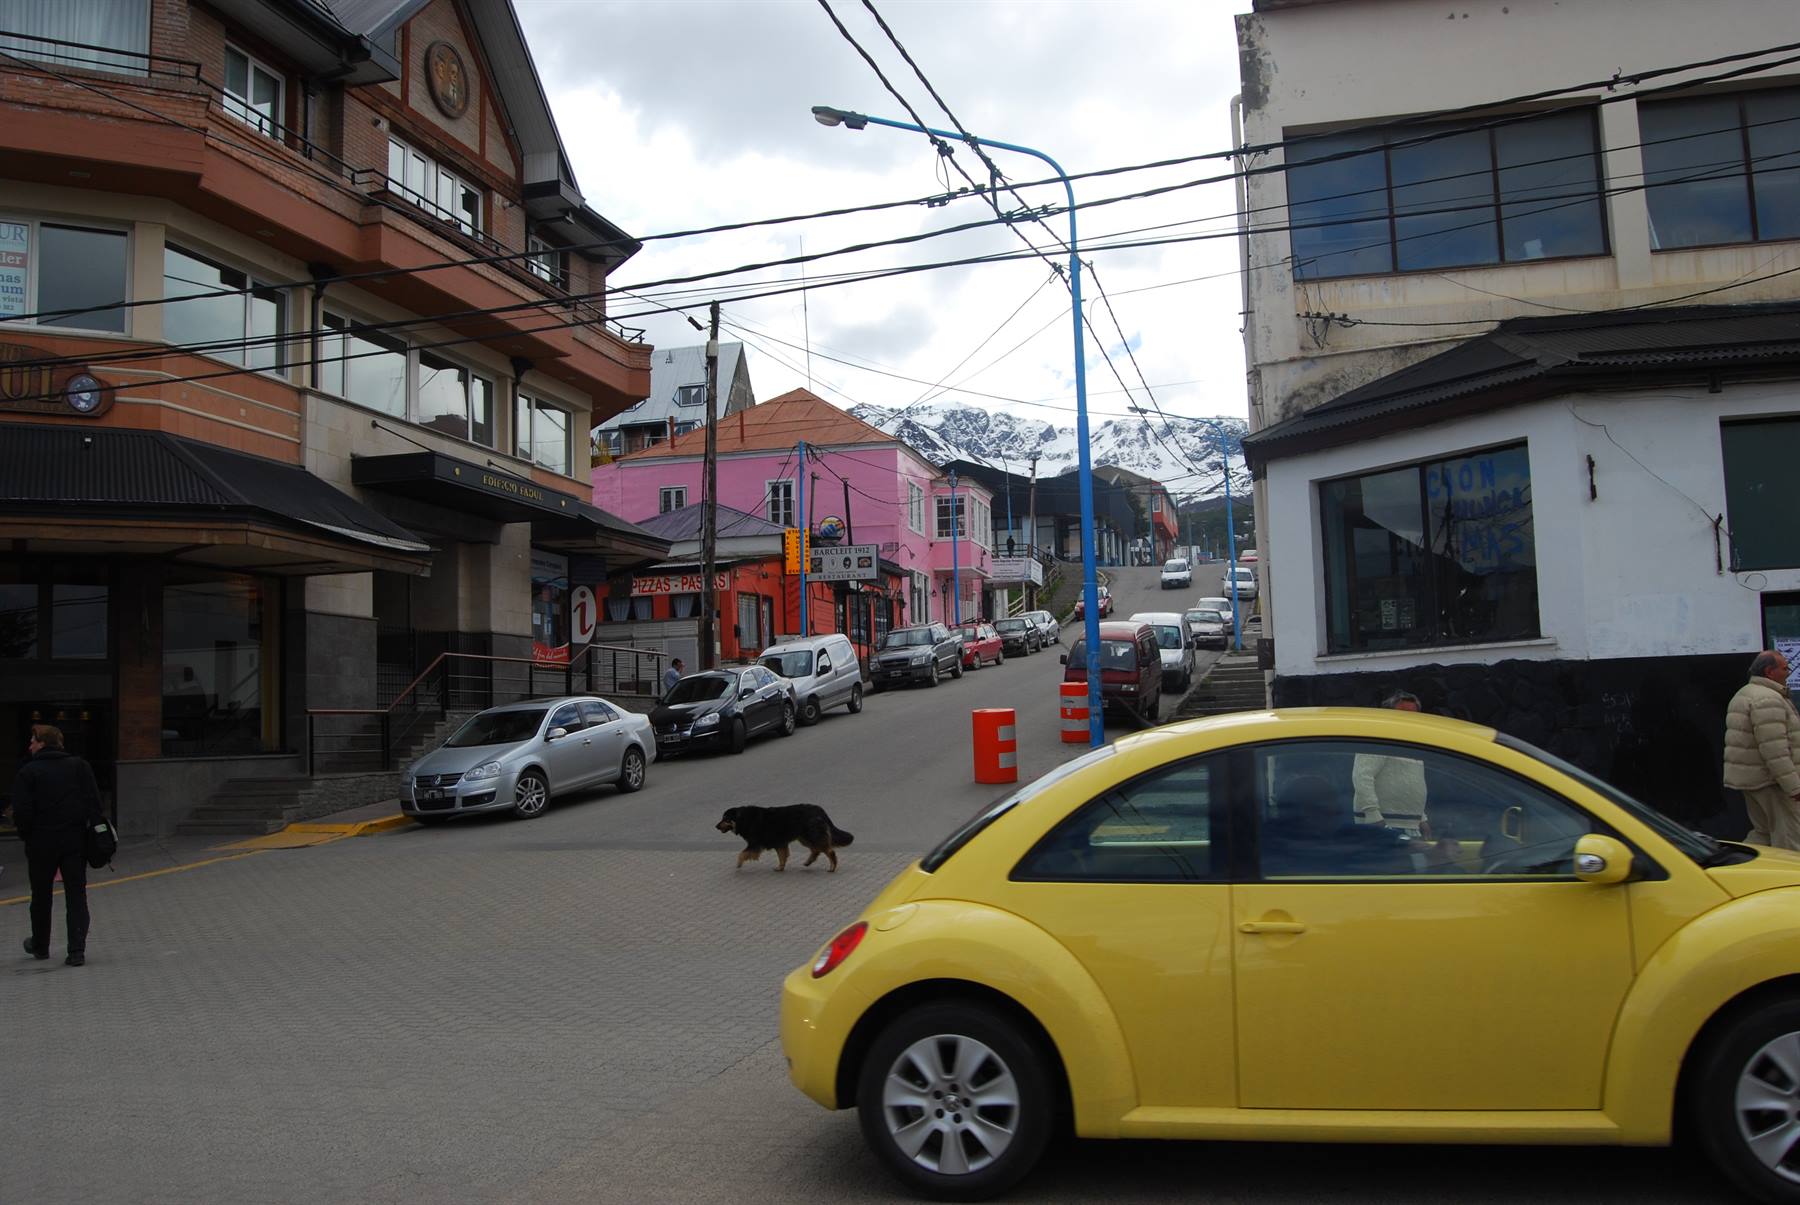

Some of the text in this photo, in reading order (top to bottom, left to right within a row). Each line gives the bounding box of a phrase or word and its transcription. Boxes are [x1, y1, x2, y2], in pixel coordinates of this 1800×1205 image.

[0, 253, 23, 264] ler
[483, 474, 517, 493] EDIFICIO
[633, 577, 671, 593] PIZZAS
[681, 574, 726, 591] PASAS
